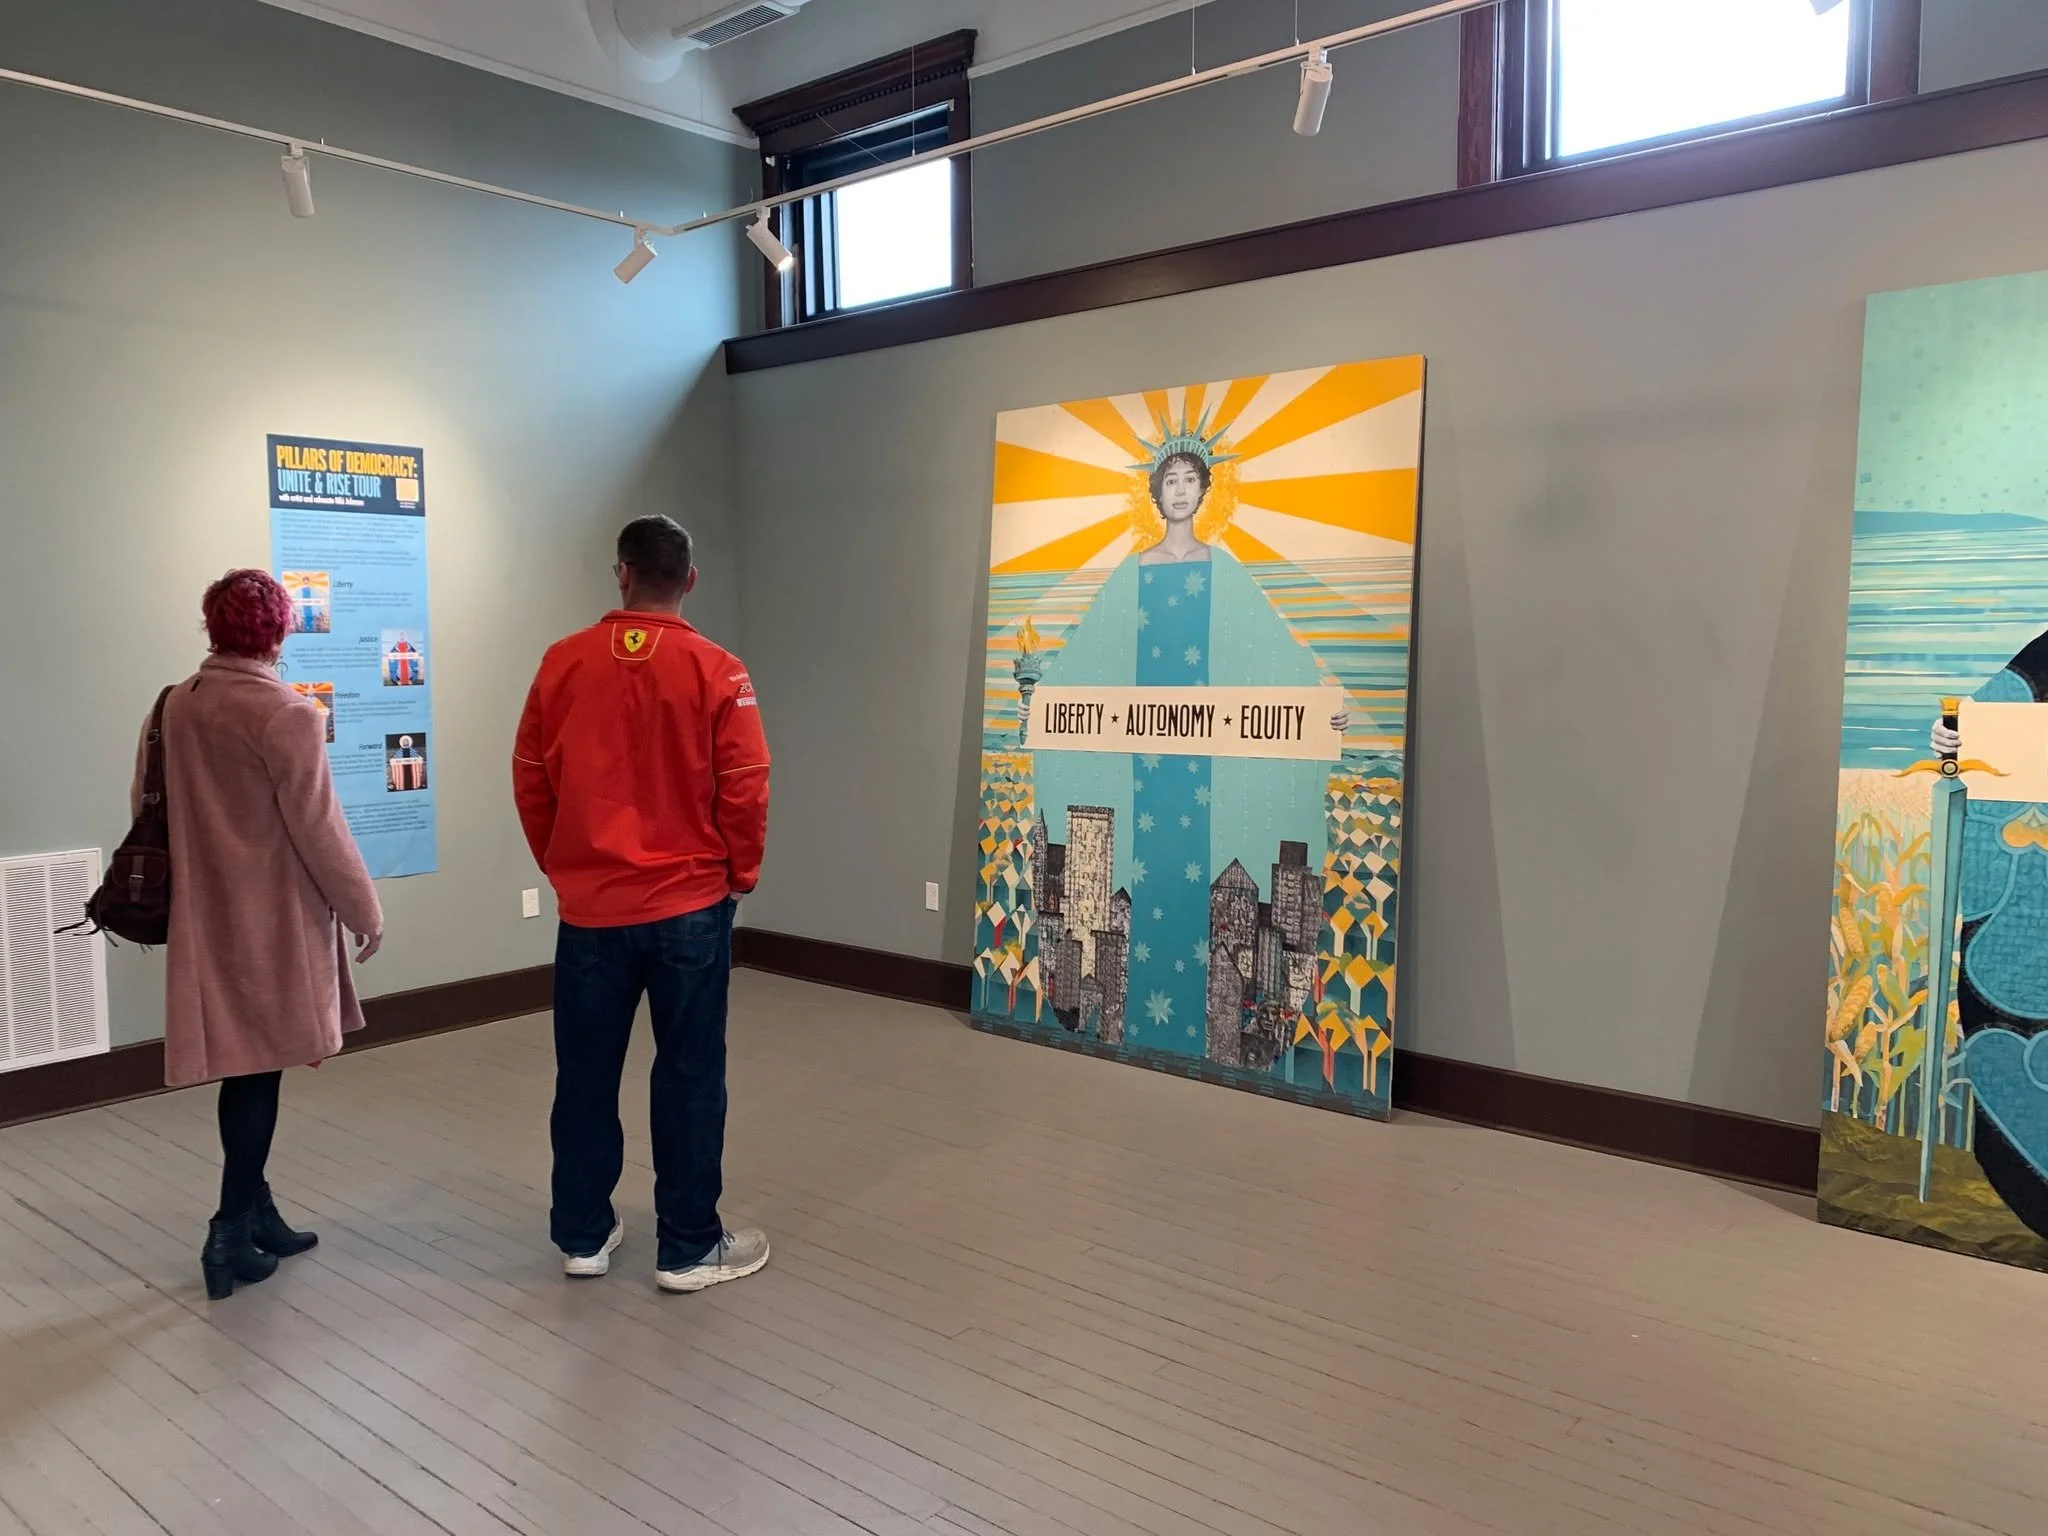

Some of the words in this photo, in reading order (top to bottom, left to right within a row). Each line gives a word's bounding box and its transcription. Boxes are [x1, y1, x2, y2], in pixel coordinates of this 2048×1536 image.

[276, 445, 327, 472] PILLARS
[328, 450, 343, 473] OF
[345, 451, 418, 478] DEMOCRACY:
[277, 469, 312, 493] UNITE
[314, 472, 323, 494] &
[325, 473, 351, 496] RISE
[353, 475, 381, 498] TOUR
[333, 580, 353, 589] Liberty
[358, 635, 378, 644] Justice
[335, 691, 360, 699] Freedom
[1044, 702, 1105, 735] LIBERTY
[1125, 703, 1216, 738] AUTONOMY
[1240, 705, 1306, 741] EQUITY
[358, 742, 383, 751] Forward
